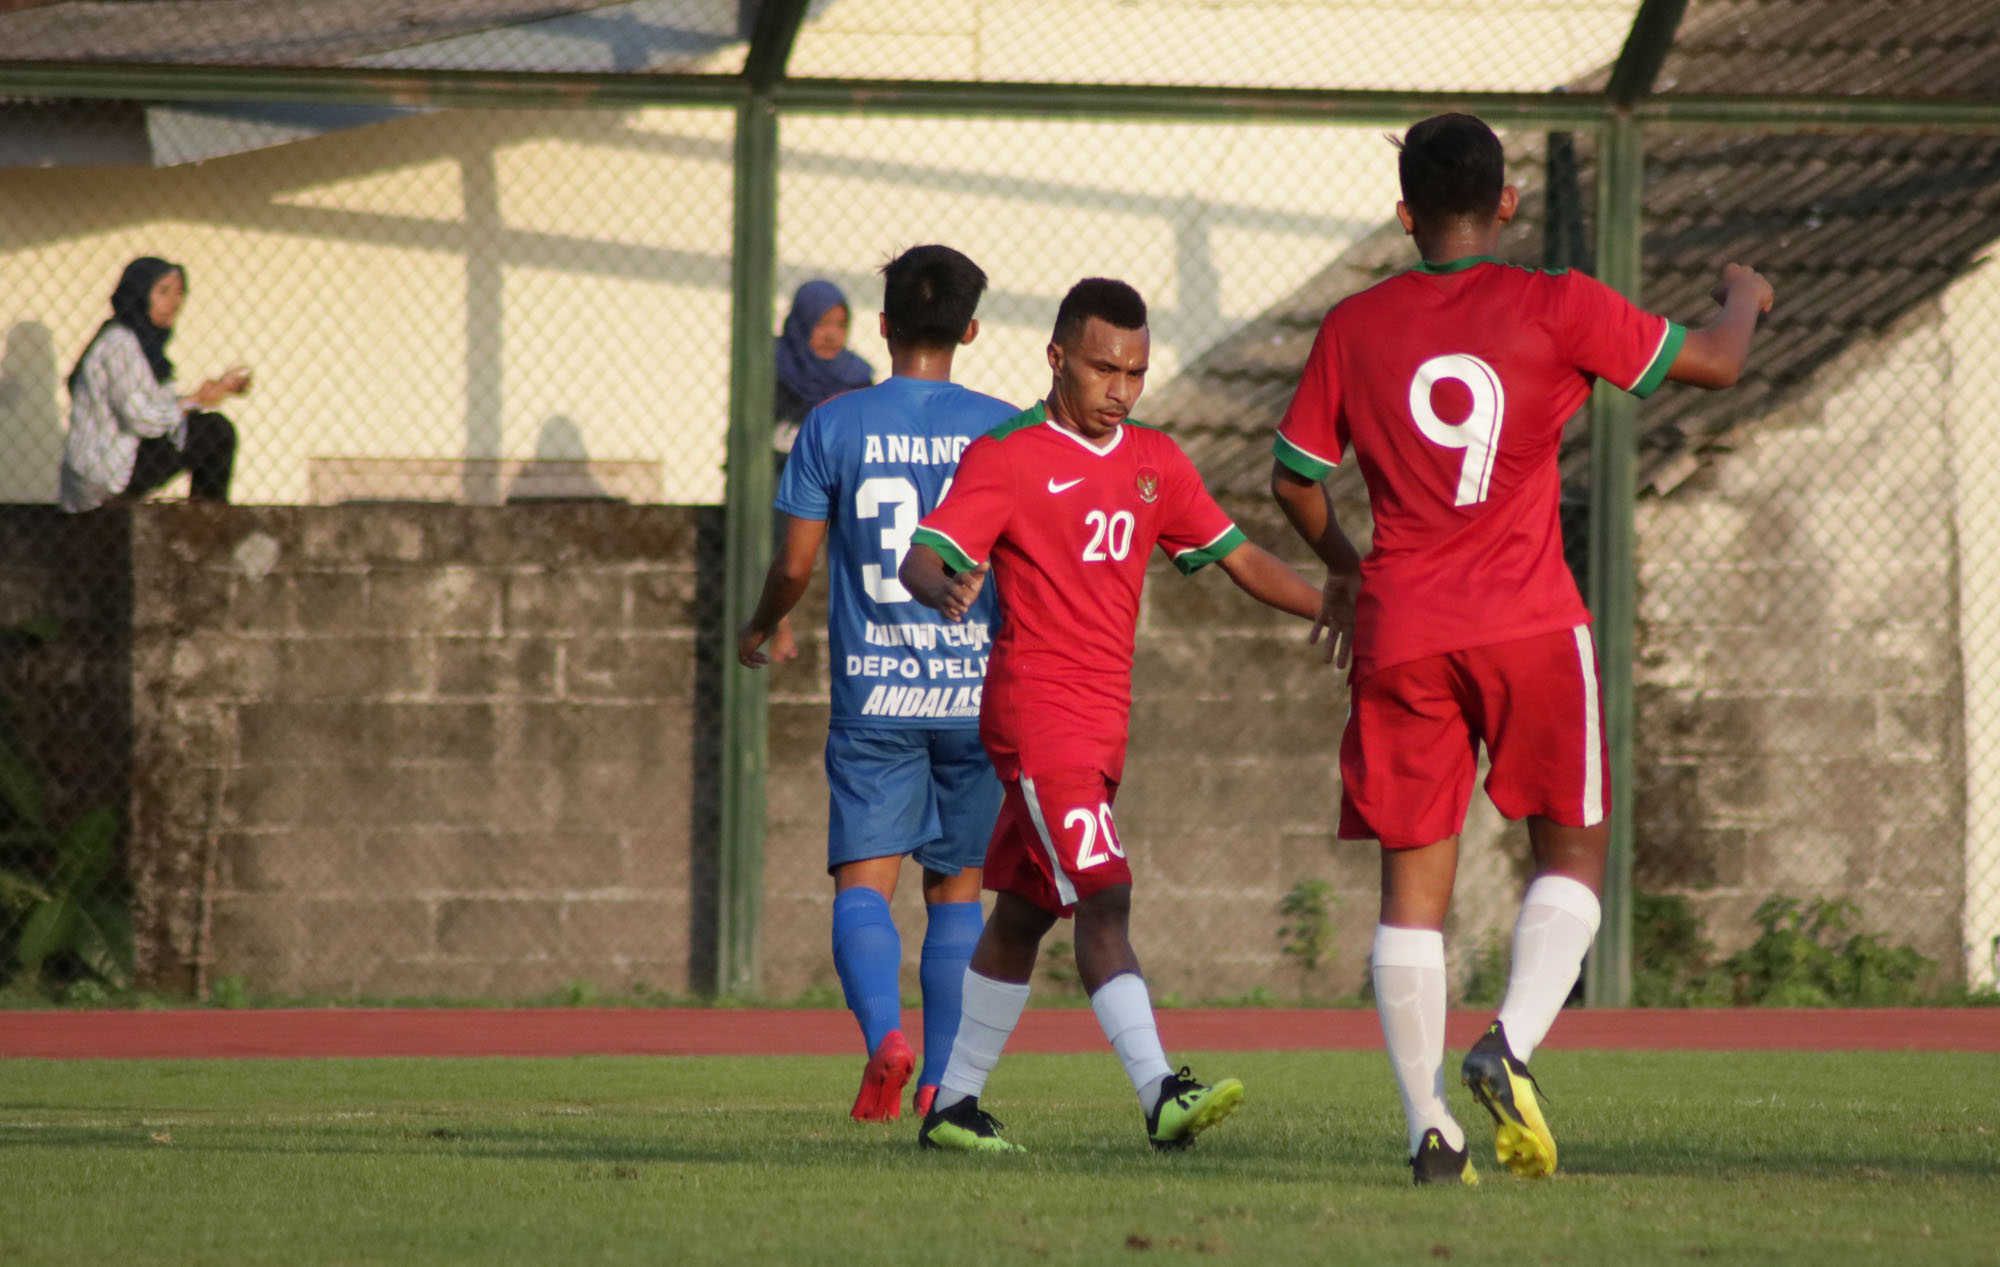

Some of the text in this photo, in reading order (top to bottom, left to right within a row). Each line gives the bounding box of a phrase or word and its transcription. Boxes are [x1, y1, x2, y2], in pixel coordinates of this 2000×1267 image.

[864, 434, 971, 465] ANANG
[1409, 353, 1504, 507] 9
[855, 477, 954, 604] 3
[1082, 510, 1135, 562] 20
[846, 655, 921, 679] DEPO
[1063, 803, 1125, 871] 20
